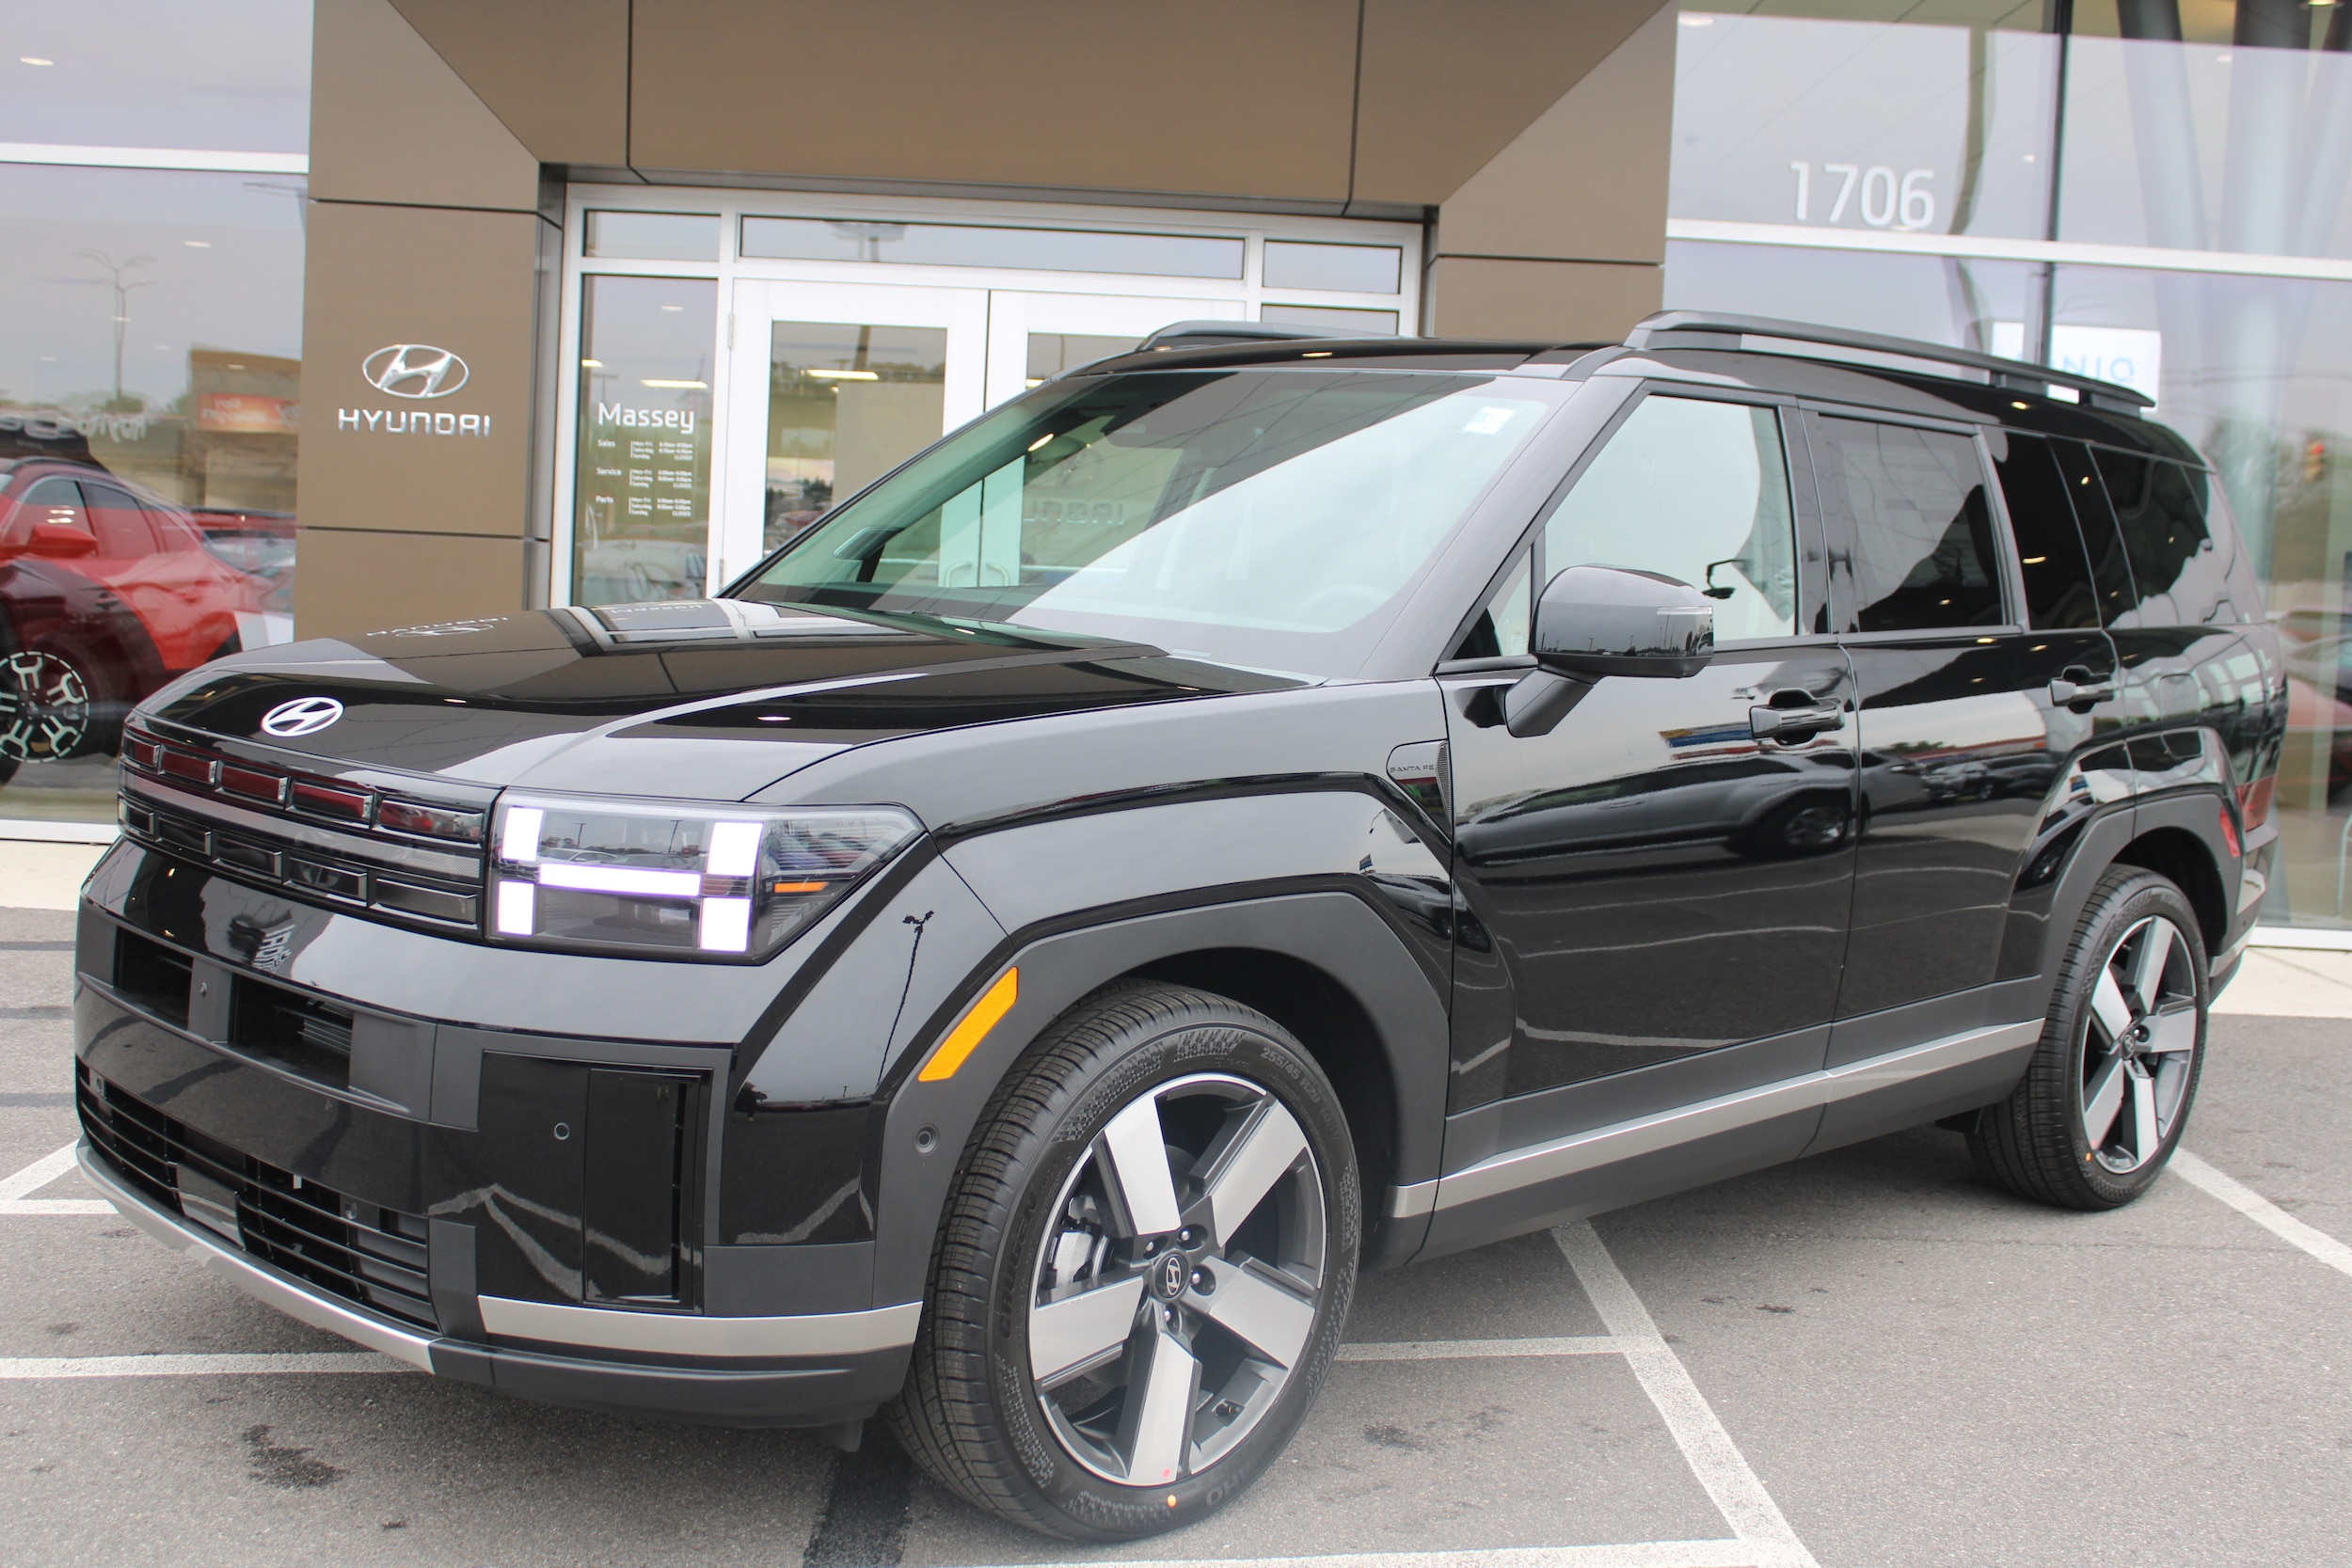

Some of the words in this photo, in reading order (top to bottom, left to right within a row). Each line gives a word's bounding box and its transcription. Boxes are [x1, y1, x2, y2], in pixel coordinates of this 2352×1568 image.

[1790, 161, 1935, 229] 1706
[337, 407, 491, 436] HYUNDAI
[597, 402, 695, 435] Massey
[597, 439, 616, 448] Sales
[596, 467, 622, 476] Service
[596, 495, 614, 503] Parts
[1260, 1044, 1301, 1082] 255/45
